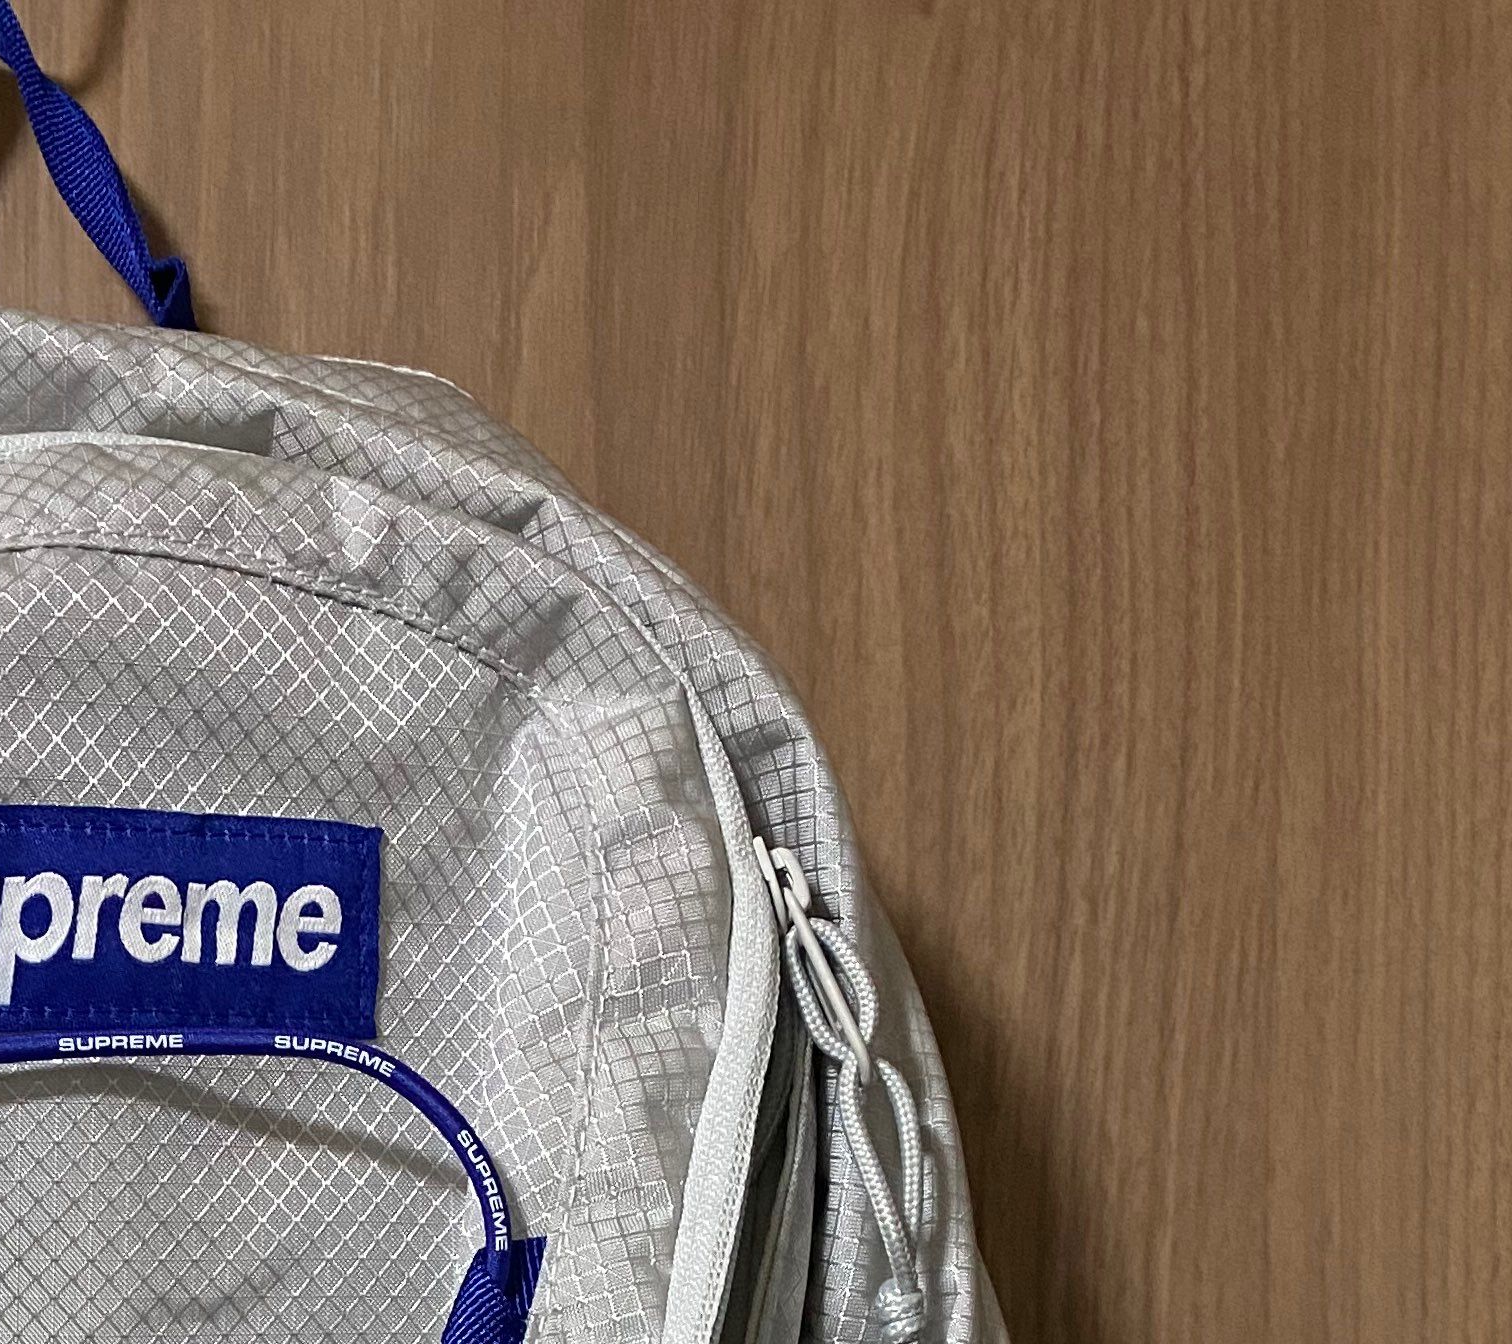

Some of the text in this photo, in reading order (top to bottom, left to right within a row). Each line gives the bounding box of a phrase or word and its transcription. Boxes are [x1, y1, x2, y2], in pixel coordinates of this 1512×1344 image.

[57, 1032, 185, 1053] SUPREME
[273, 1033, 397, 1078] SUPREME
[457, 1128, 510, 1252] SUPREME
